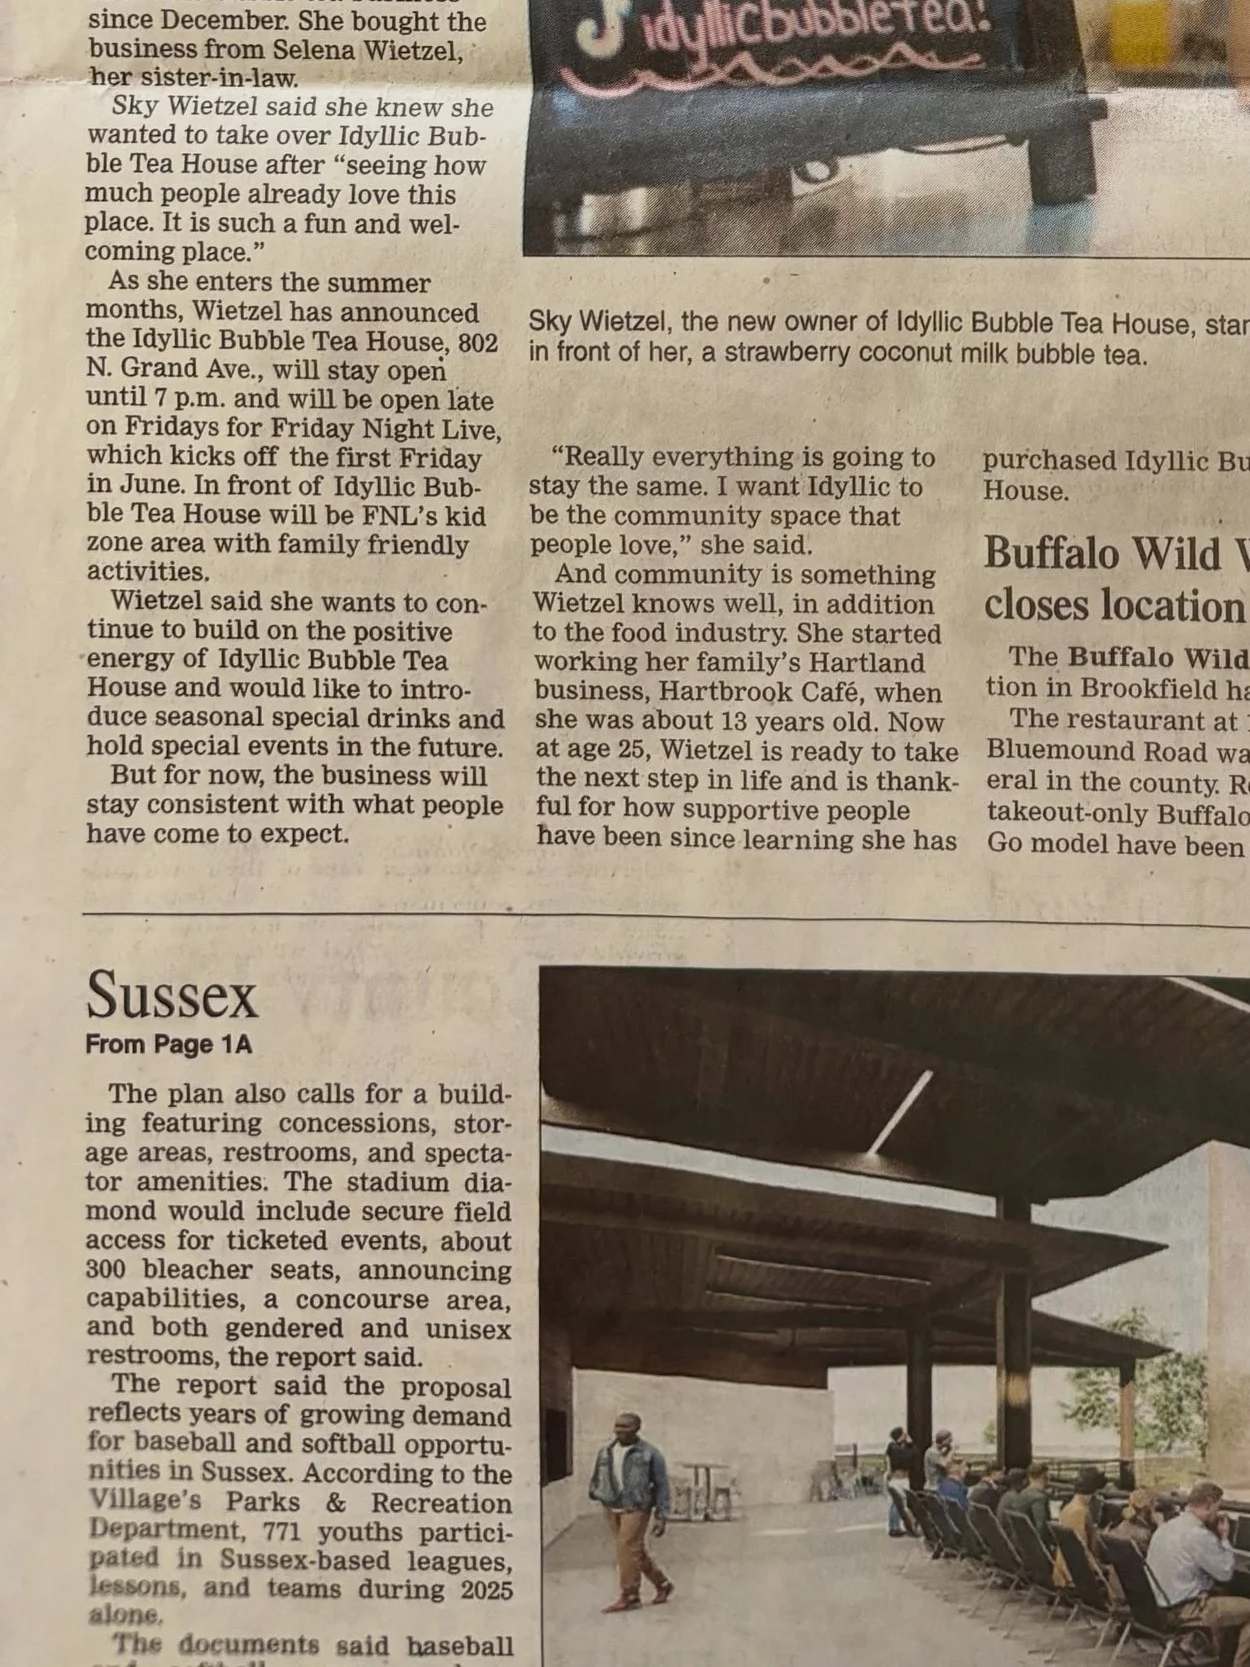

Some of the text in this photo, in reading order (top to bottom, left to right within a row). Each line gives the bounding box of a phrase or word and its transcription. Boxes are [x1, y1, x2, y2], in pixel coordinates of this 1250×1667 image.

[86, 240, 175, 265] coming
[530, 309, 572, 336] Sky
[580, 310, 672, 334] Wietzel,
[681, 310, 718, 331] the
[729, 315, 776, 331] new
[785, 315, 858, 331] owner
[866, 310, 888, 331] of
[898, 310, 962, 337] Idyllic
[972, 310, 1053, 333] Bubble
[1061, 312, 1103, 334] Tea
[1113, 313, 1195, 338] House,
[530, 340, 1147, 367] in front of her, a strawberry coconut milk bubble tea.
[984, 480, 1068, 501] House.
[984, 534, 1119, 569] Buffalo
[1132, 536, 1222, 570] Wild
[88, 558, 209, 587] activities.
[985, 586, 1246, 623] closes location
[534, 678, 942, 706] business, Hartbrook Café, when
[1010, 708, 1058, 728] The
[1068, 710, 1205, 730] restaurant
[1214, 712, 1238, 732] at
[88, 969, 259, 1018] Sussex
[86, 1034, 252, 1059] From Page 1A
[87, 1286, 510, 1314] capabilities, a concourse area,
[227, 1491, 300, 1512] Parks
[326, 1492, 346, 1512] &
[372, 1492, 512, 1514] Recreation
